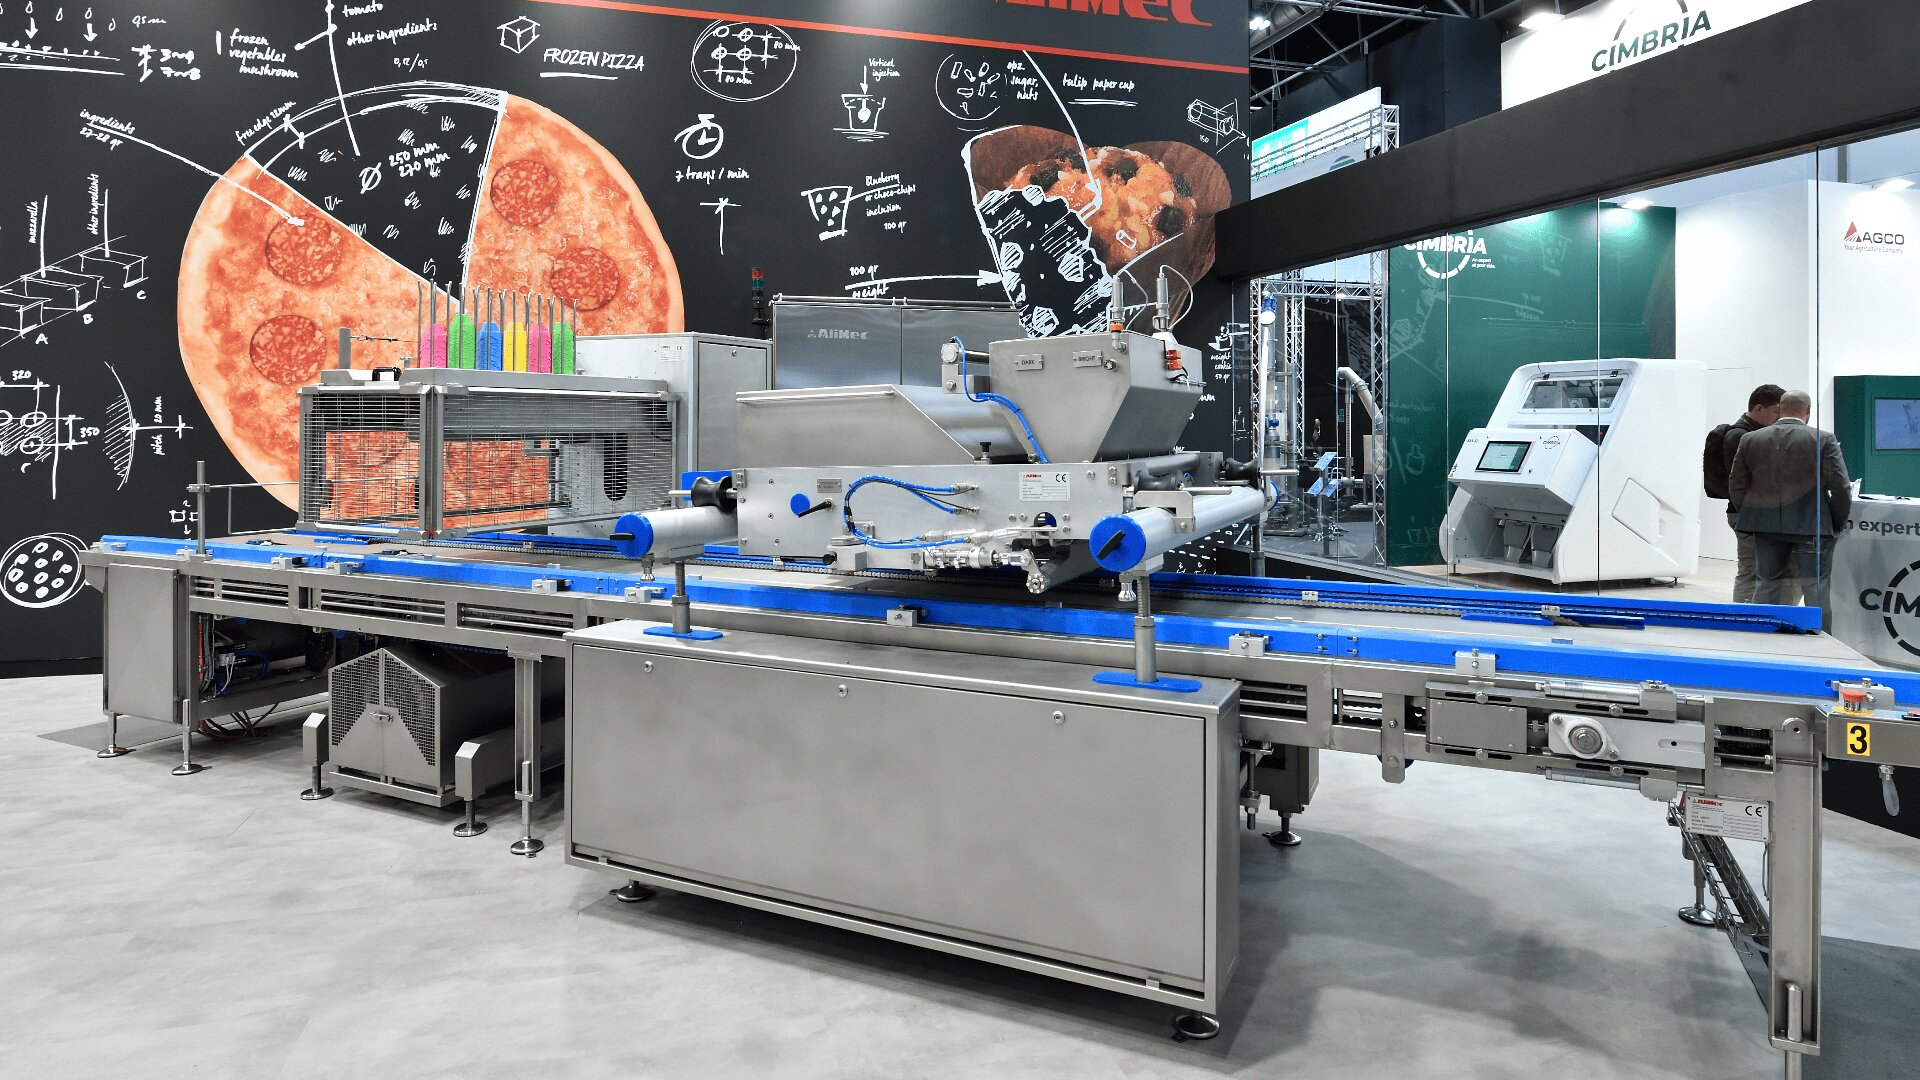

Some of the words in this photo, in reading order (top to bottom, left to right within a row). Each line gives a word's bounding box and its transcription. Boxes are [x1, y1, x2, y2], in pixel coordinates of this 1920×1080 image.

[342, 0, 384, 18] tomato
[229, 28, 269, 47] frozen
[347, 31, 375, 46] other
[376, 17, 437, 45] ingredients
[1591, 10, 1711, 72] CIMBRIA
[229, 47, 287, 65] vegetables
[543, 48, 600, 67] FROZEN
[601, 51, 645, 72] PIZZA
[868, 57, 896, 68] Vertical
[239, 64, 300, 79] mushroom
[872, 67, 901, 82] injection
[1010, 75, 1039, 91] sugar,
[1062, 72, 1088, 91] tulip
[1092, 78, 1118, 92] paper
[1118, 80, 1136, 92] cup
[1016, 87, 1039, 100] nuts
[80, 108, 136, 135] ingredients
[235, 128, 255, 147] free
[254, 116, 272, 131] edge
[110, 138, 124, 151] gr
[388, 150, 411, 168] 250
[413, 142, 440, 158] mm
[398, 160, 422, 178] 270
[423, 152, 451, 168] mm
[685, 165, 716, 185] trays
[727, 167, 750, 179] min
[865, 171, 901, 187] Blueberry
[86, 173, 105, 215] ingredients
[866, 203, 902, 217] inclusion
[898, 220, 907, 234] gr
[1862, 231, 1905, 245] AGCO
[867, 264, 880, 281] gr
[136, 289, 147, 300] C
[852, 281, 890, 299] weight
[83, 313, 94, 325] B
[35, 333, 48, 345] A
[818, 328, 870, 340] AliMec
[12, 370, 32, 381] 320
[79, 426, 101, 438] 350
[1859, 519, 1920, 537] expert
[1849, 725, 1868, 754] 3
